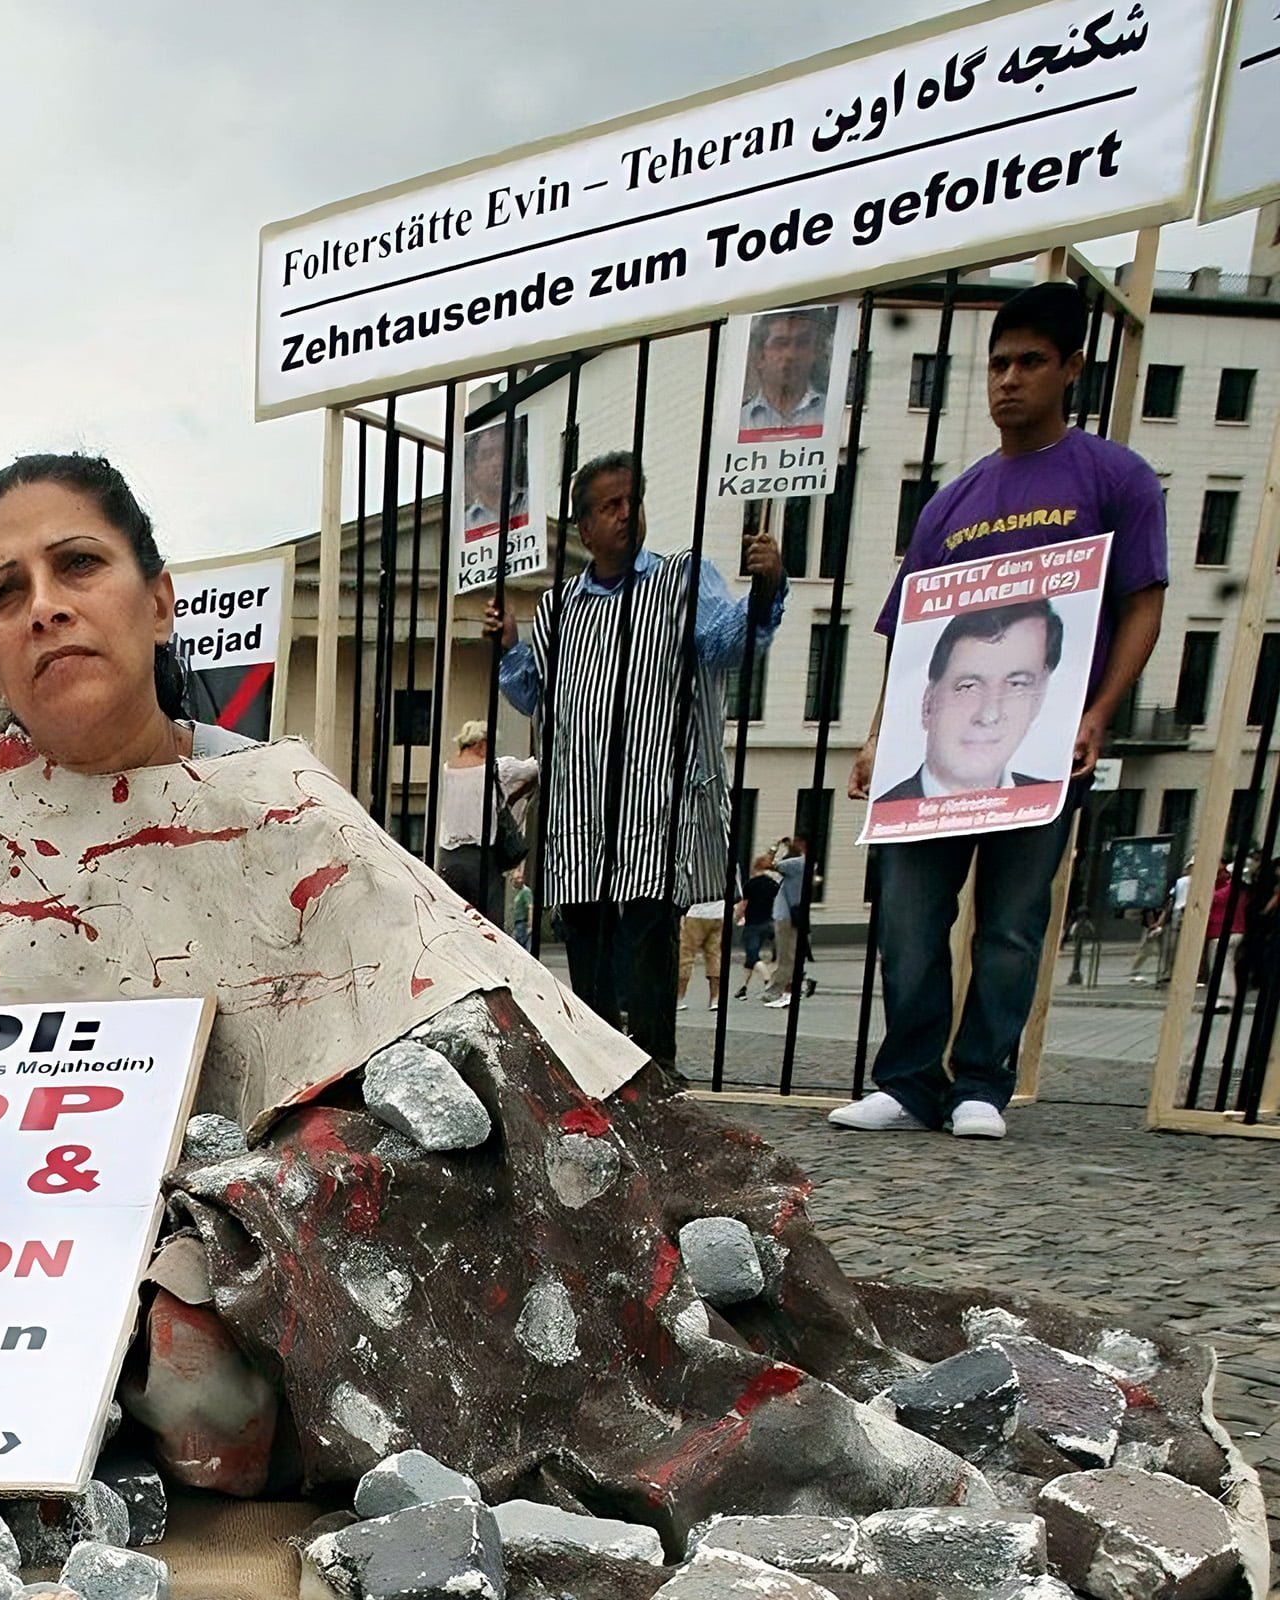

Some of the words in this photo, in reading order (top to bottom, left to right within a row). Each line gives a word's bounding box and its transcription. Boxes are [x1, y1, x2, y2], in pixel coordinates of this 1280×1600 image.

[998, 3, 1149, 93] شکنجه
[917, 46, 988, 110] گاه
[812, 69, 906, 152] اوین
[282, 203, 474, 287] Folterstätte
[486, 175, 571, 230] Evin
[622, 115, 794, 192] Teheran
[281, 270, 575, 373] Zehntausende
[588, 244, 688, 296] zum
[706, 210, 831, 270] Tode
[851, 129, 1123, 250] gefoltert
[718, 468, 827, 496] Kazemi
[725, 451, 767, 473] Ich
[779, 447, 824, 468] bin
[461, 546, 493, 568] Ich
[916, 561, 994, 593] RETTET
[997, 559, 1033, 577] den
[1040, 547, 1096, 567] Vater
[920, 594, 955, 615] ALI
[27, 1145, 100, 1195] &
